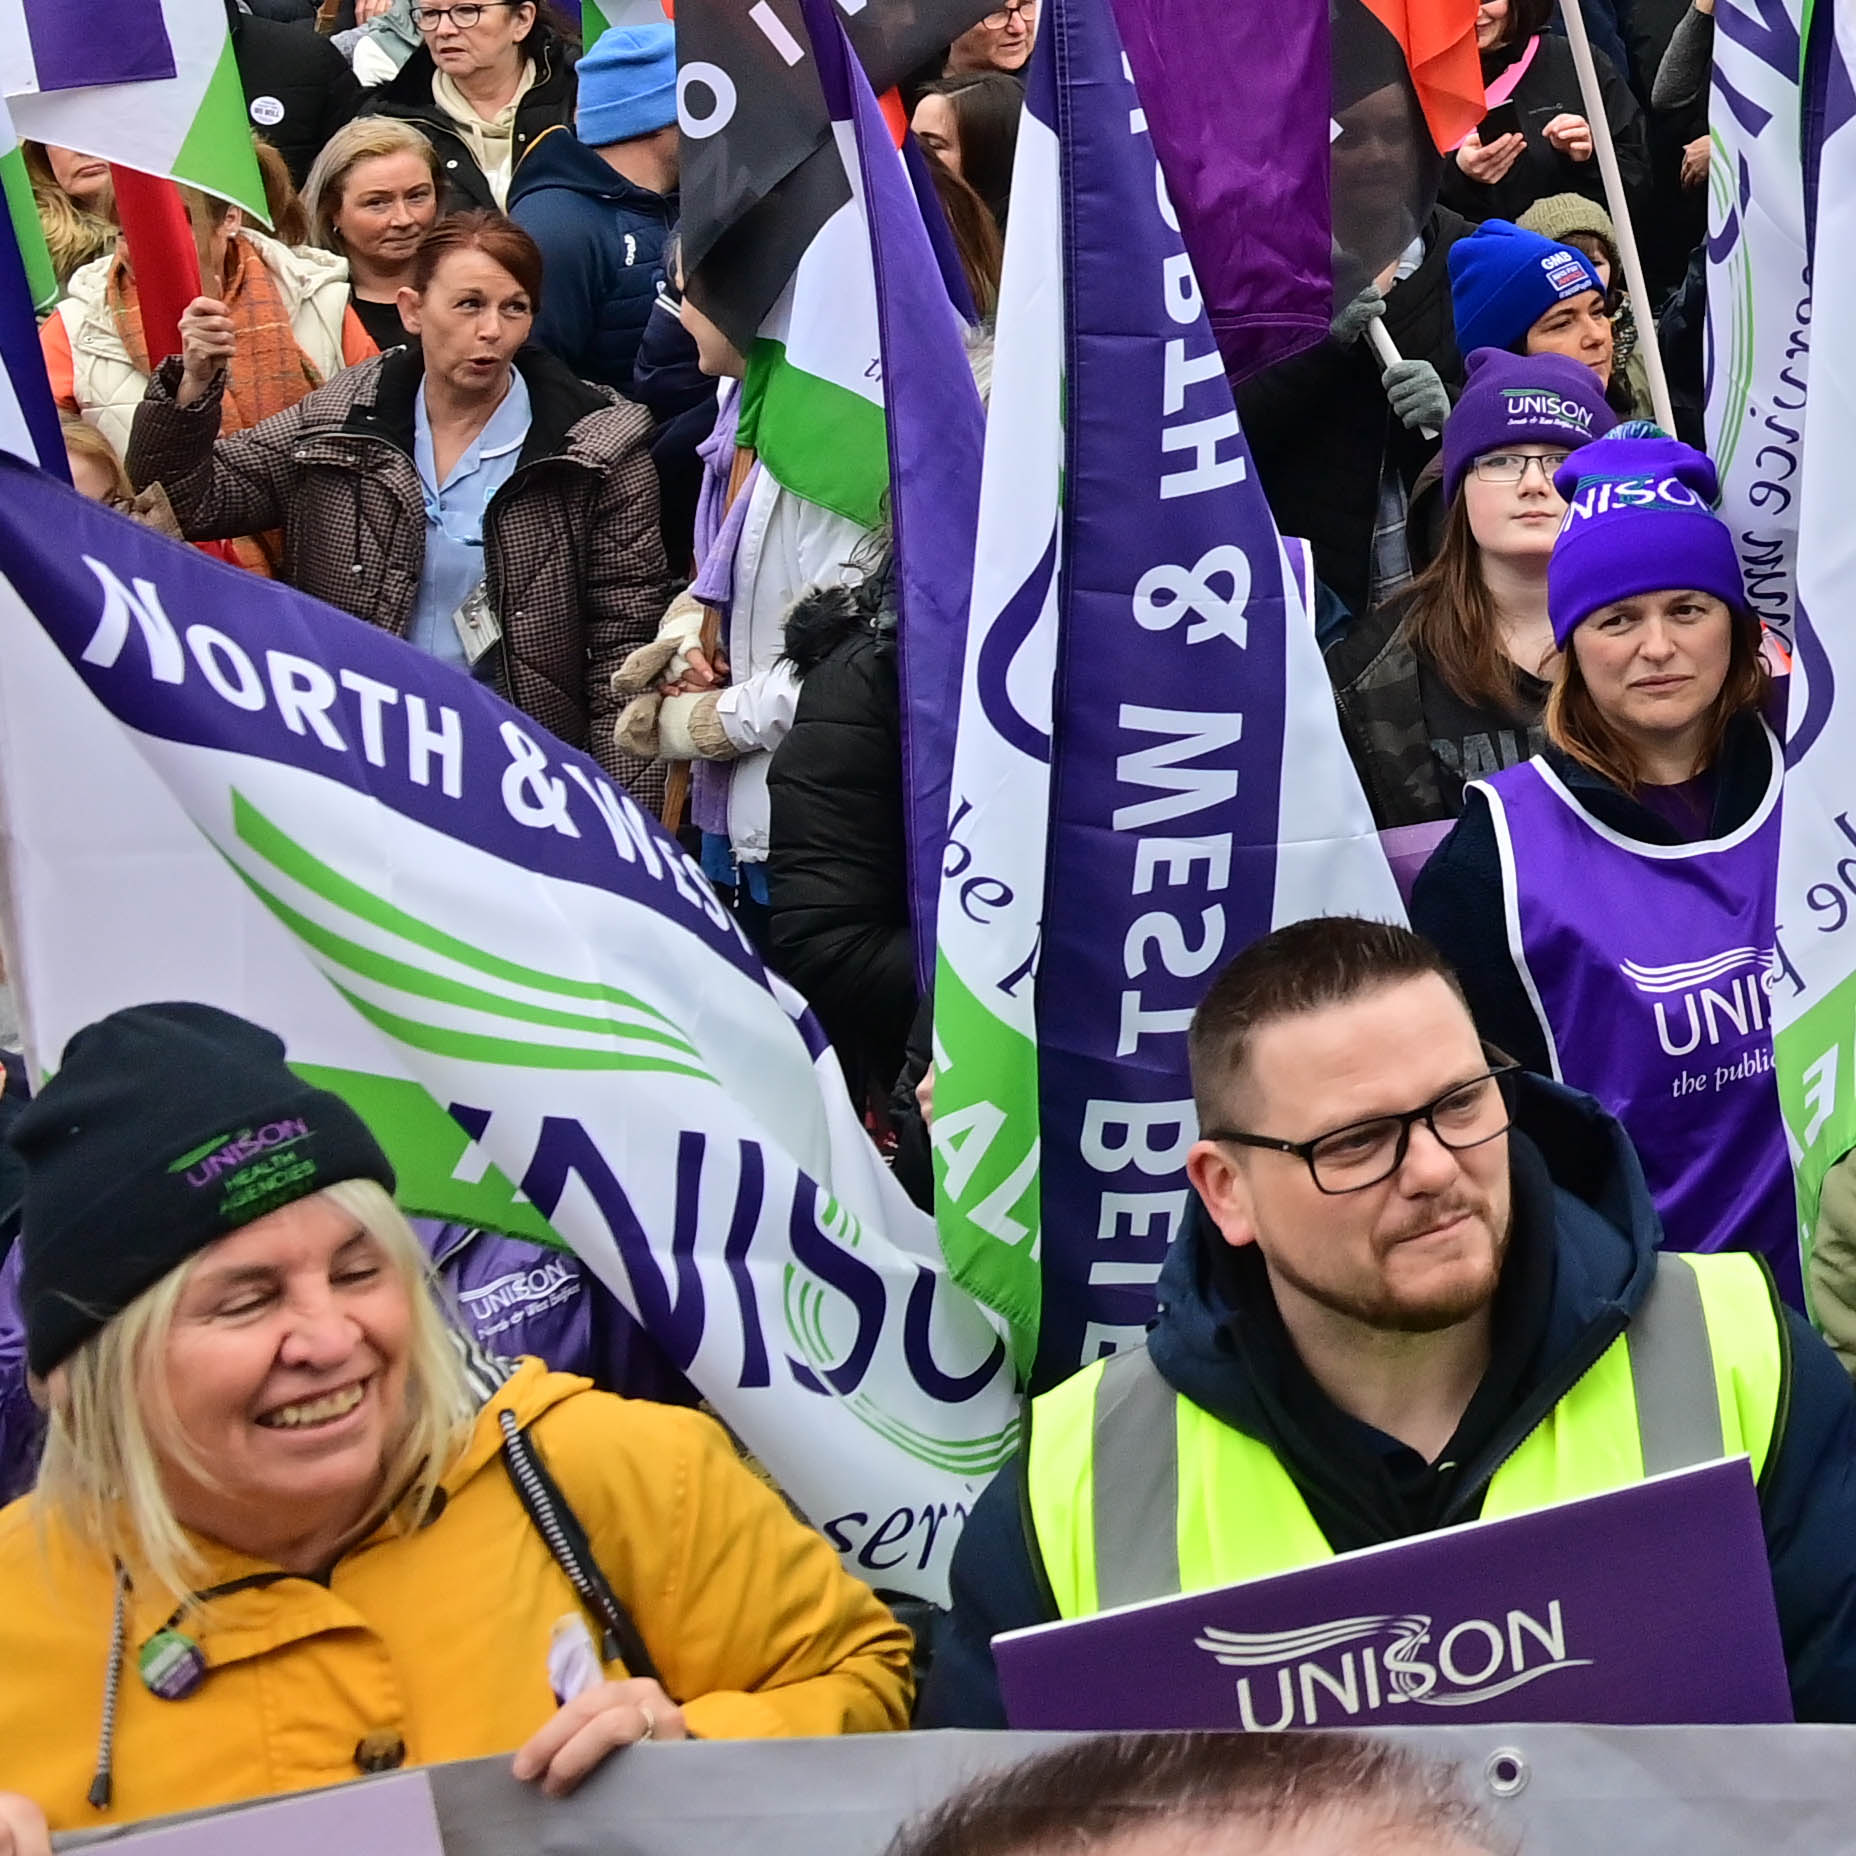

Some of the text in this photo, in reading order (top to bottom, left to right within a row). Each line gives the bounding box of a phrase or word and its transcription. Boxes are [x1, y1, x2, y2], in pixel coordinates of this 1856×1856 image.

[1541, 250, 1573, 271] GMB
[1508, 396, 1593, 428] UNISON
[1563, 477, 1712, 533] NISO
[81, 552, 464, 802] NORTH
[500, 719, 584, 840] &
[1670, 1065, 1706, 1101] the
[184, 1118, 309, 1188] UNISON
[470, 1259, 567, 1320] UNISON
[1236, 1598, 1569, 1733] UNISON
